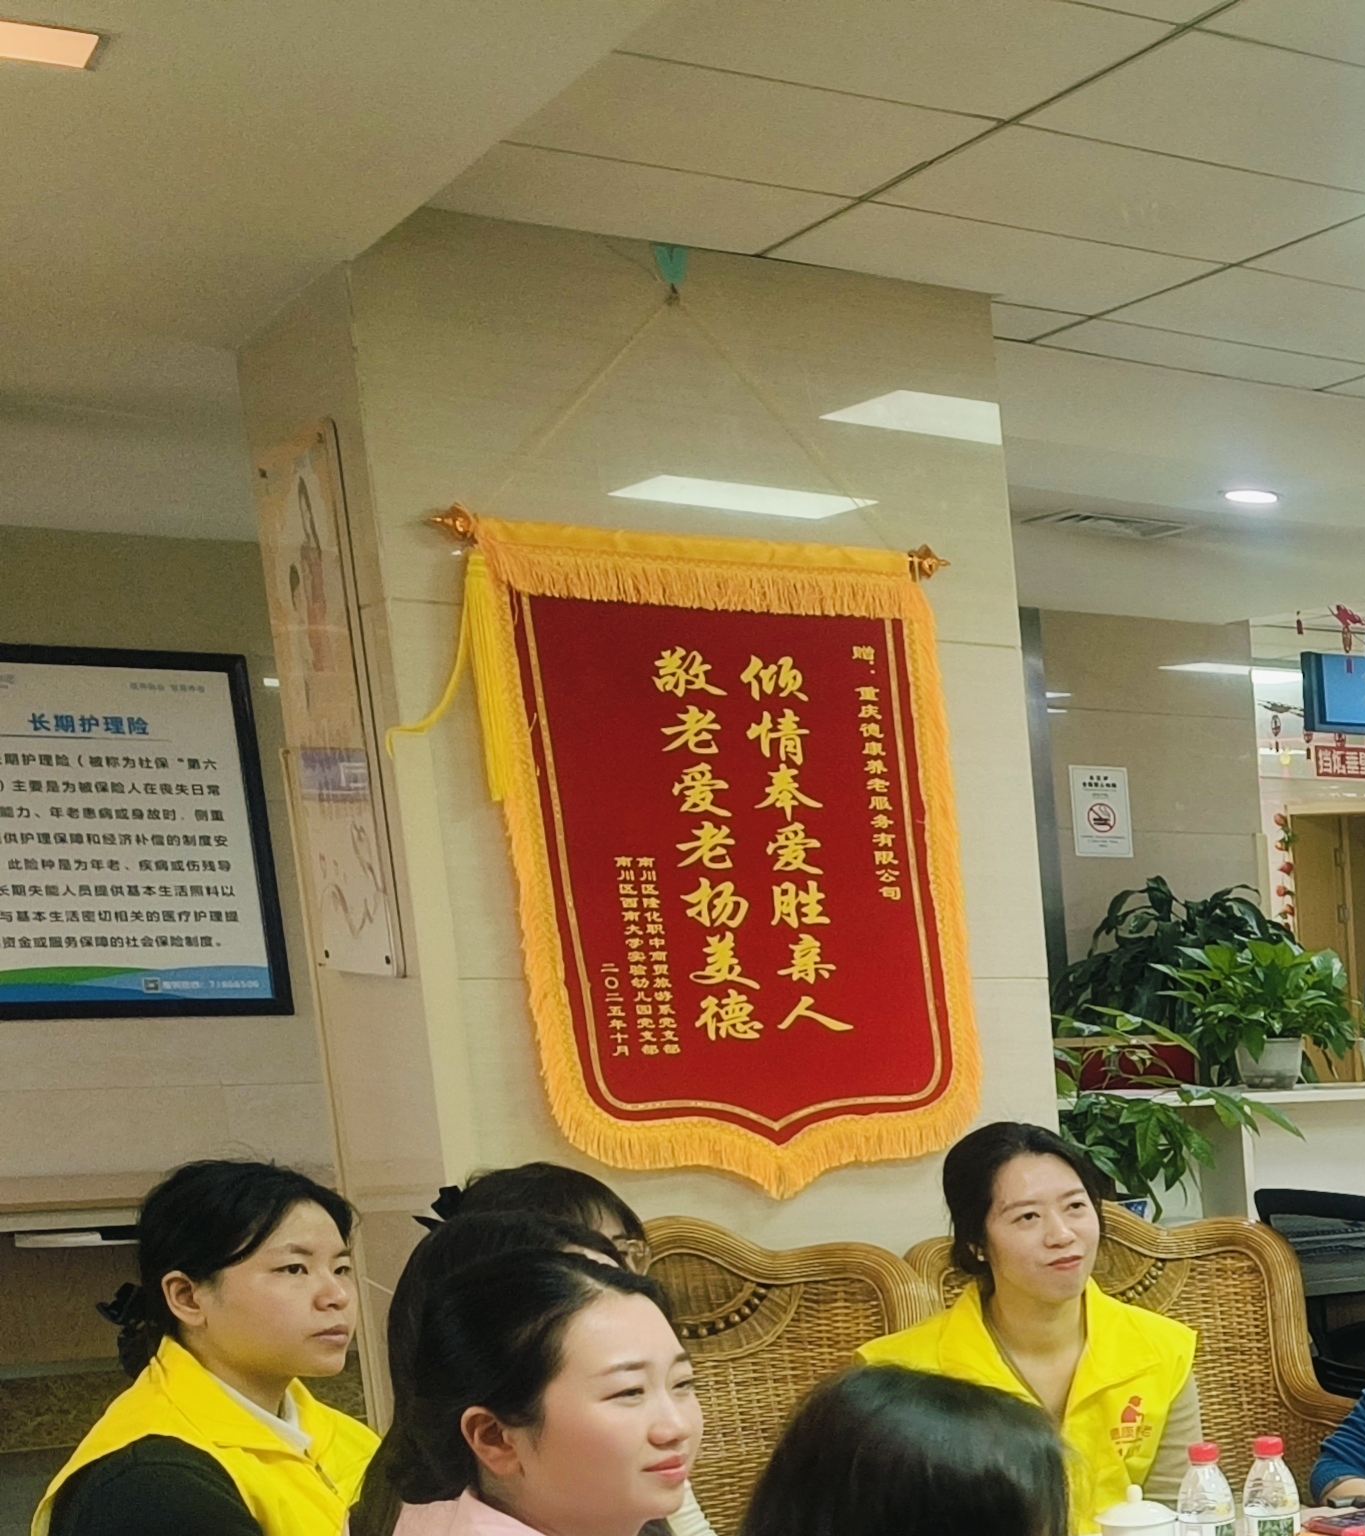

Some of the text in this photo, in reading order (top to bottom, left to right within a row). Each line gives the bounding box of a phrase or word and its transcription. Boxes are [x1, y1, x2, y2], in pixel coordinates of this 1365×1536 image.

[28, 712, 151, 736] 长期护理险
[0, 752, 218, 772] 期护理险（被称为社保“第六
[852, 644, 901, 901] 赠：重庆德康养老服务有限公司
[0, 831, 229, 848] 供护理保障和经济补偿的制度安
[650, 645, 765, 1042] 敬老爱老扬美德
[740, 654, 854, 1033] 倾情奉爱胜亲人
[0, 935, 222, 949] 资金或服务保障的社会保险制度。
